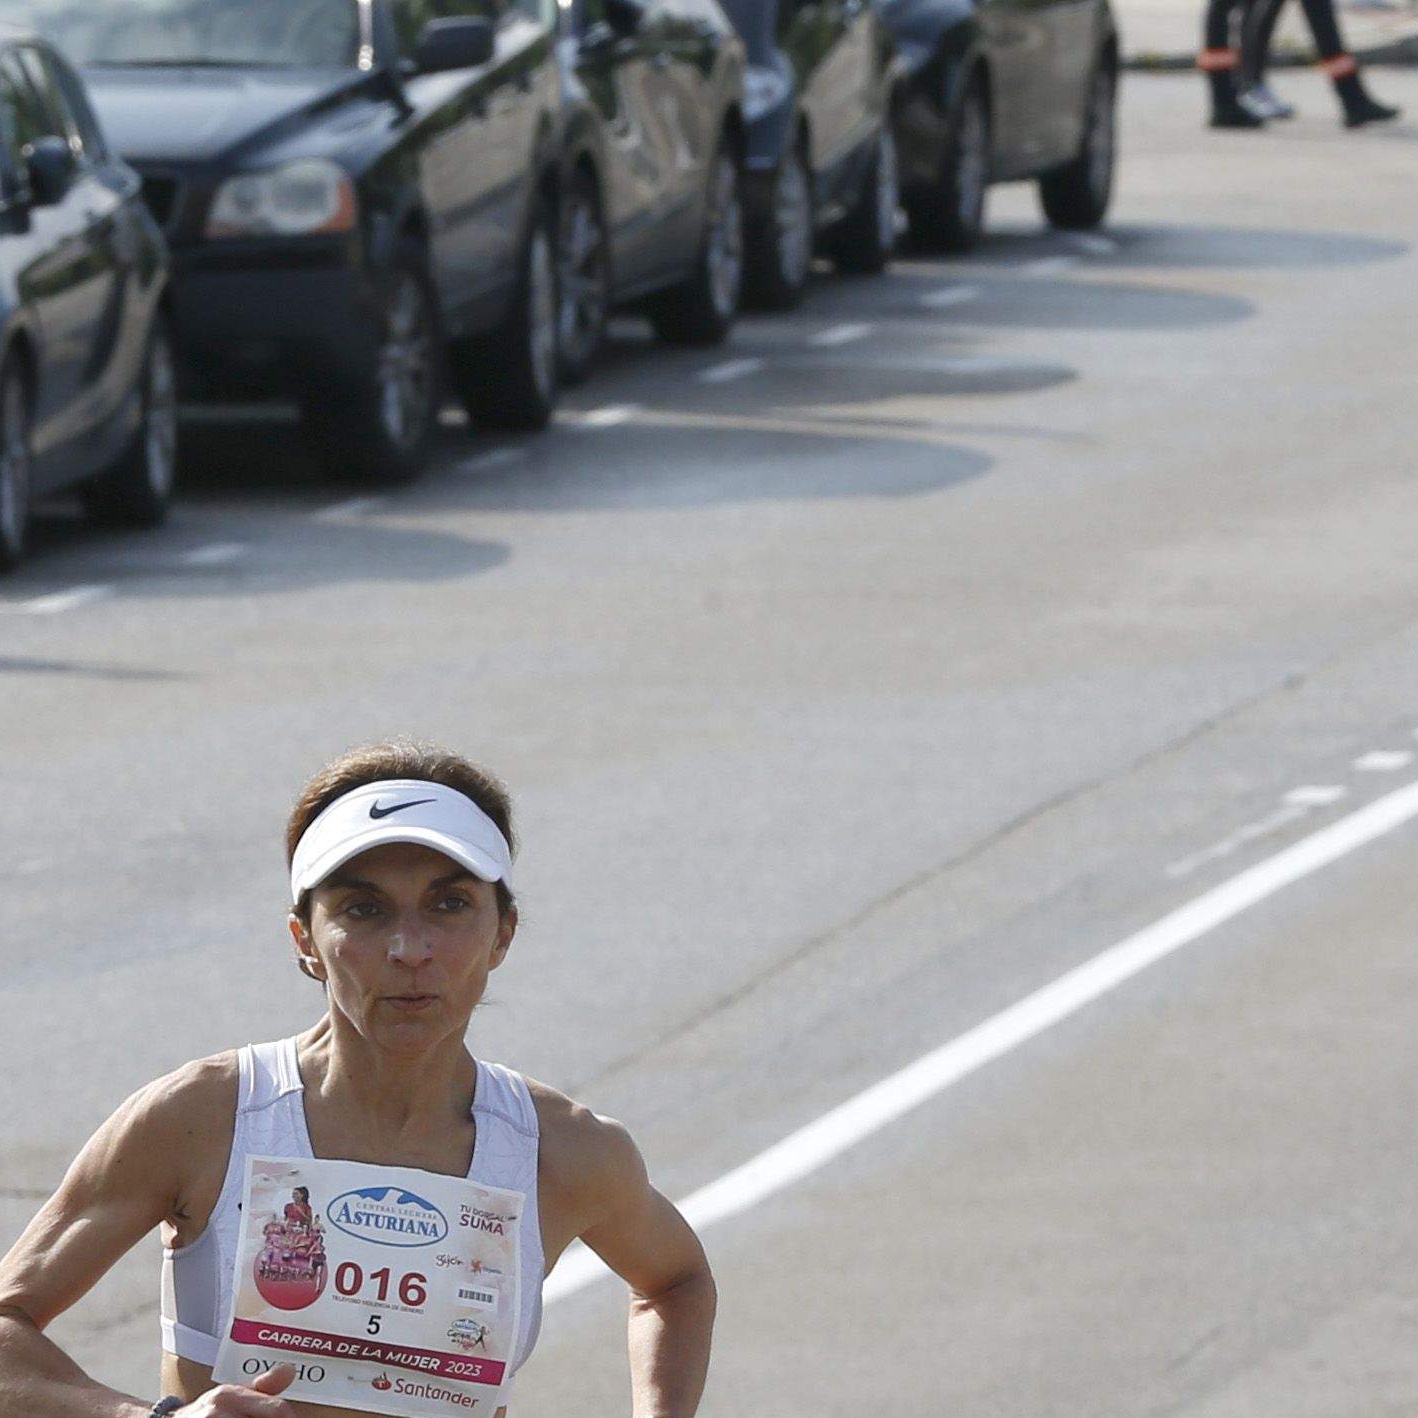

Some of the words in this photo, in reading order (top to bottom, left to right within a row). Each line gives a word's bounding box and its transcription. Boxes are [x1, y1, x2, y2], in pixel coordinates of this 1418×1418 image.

[336, 1201, 439, 1237] ASTURIANA
[459, 1214, 504, 1236] SUMA
[335, 1262, 427, 1306] 016
[366, 1315, 381, 1335] 5
[257, 1329, 332, 1350] CARRERA
[336, 1343, 360, 1355] DE
[361, 1347, 381, 1358] LA
[385, 1351, 441, 1370] MUJER
[445, 1361, 482, 1376] 2023
[243, 1358, 325, 1382] OYHO
[394, 1378, 479, 1408] Santander
